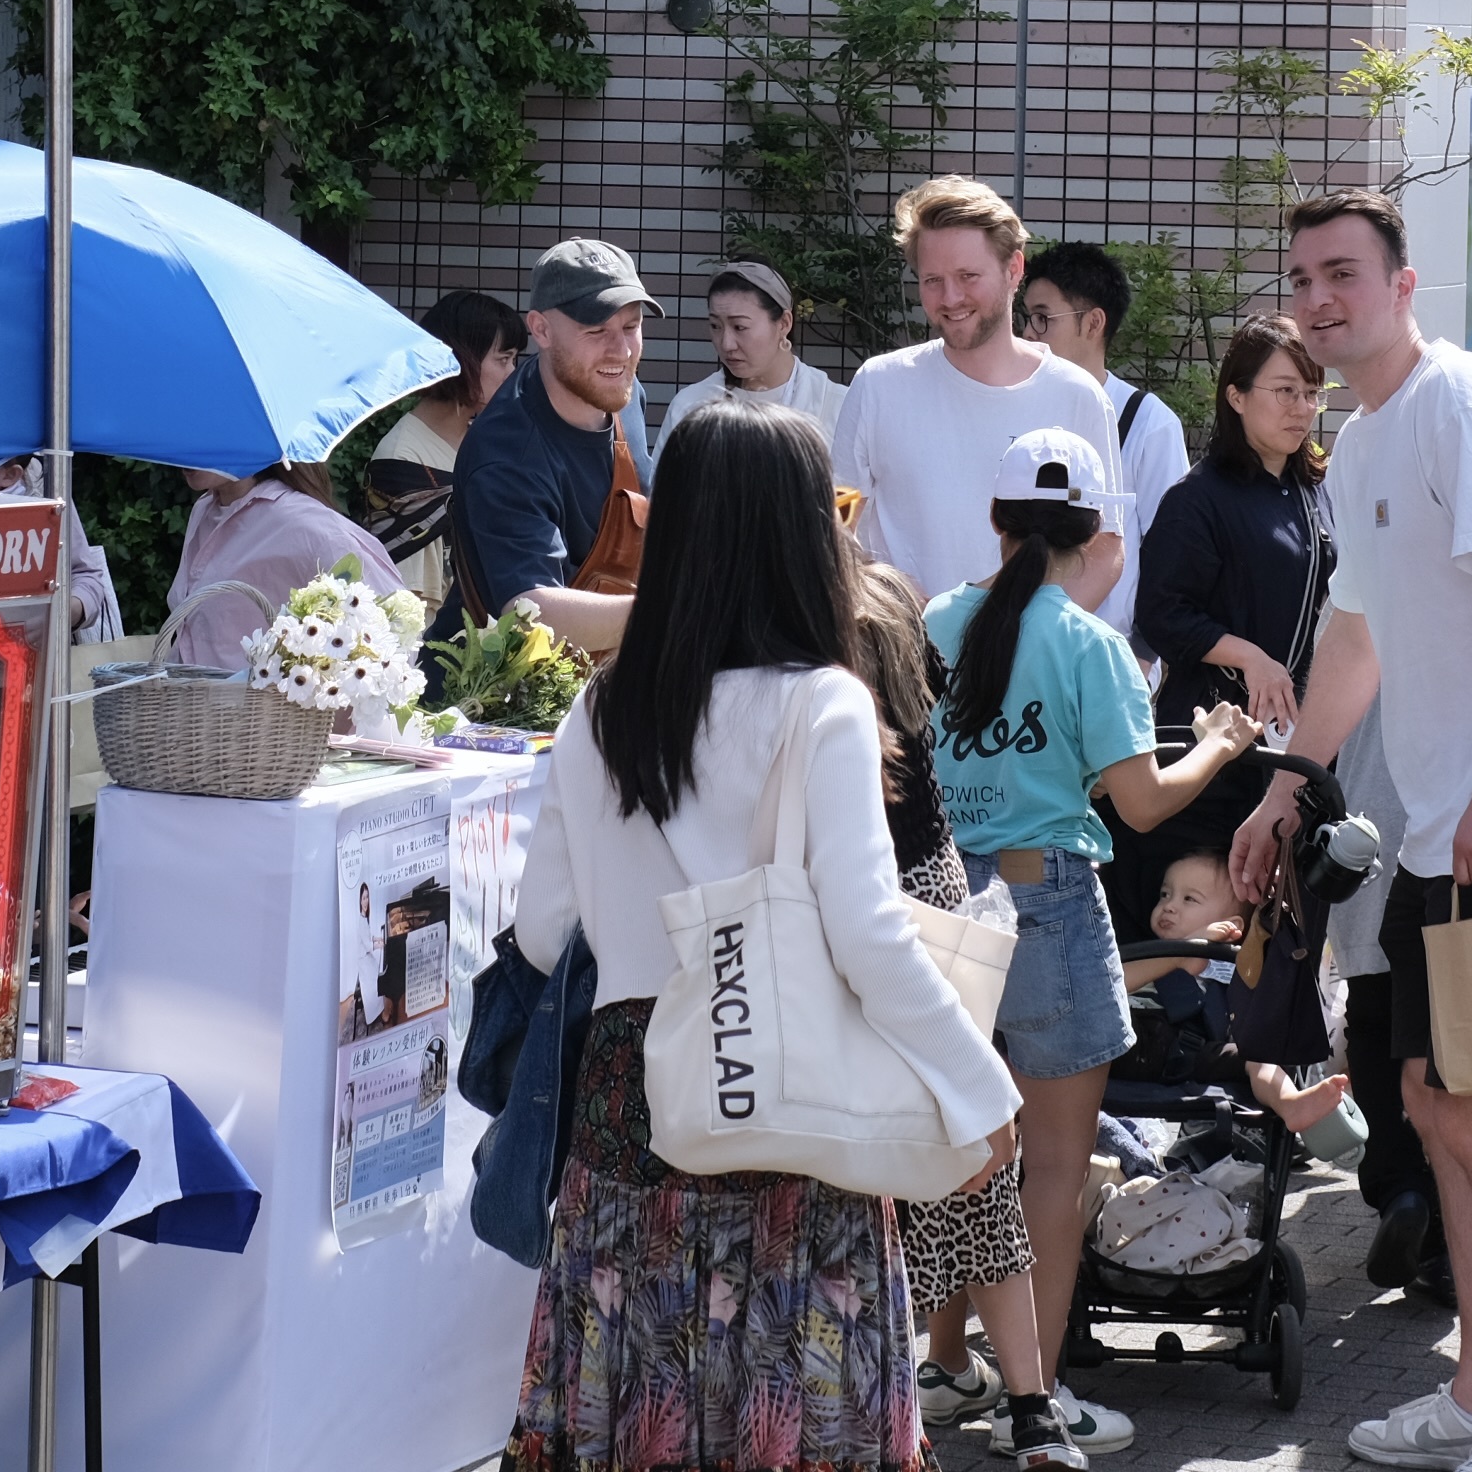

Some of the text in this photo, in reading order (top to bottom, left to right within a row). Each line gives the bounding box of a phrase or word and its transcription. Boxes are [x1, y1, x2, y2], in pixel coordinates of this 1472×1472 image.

[584, 252, 618, 266] TOKYO
[942, 785, 1006, 803] DWICH
[360, 795, 437, 834] PIANO STUDIO GIFT
[710, 921, 756, 1120] HEXCLAD
